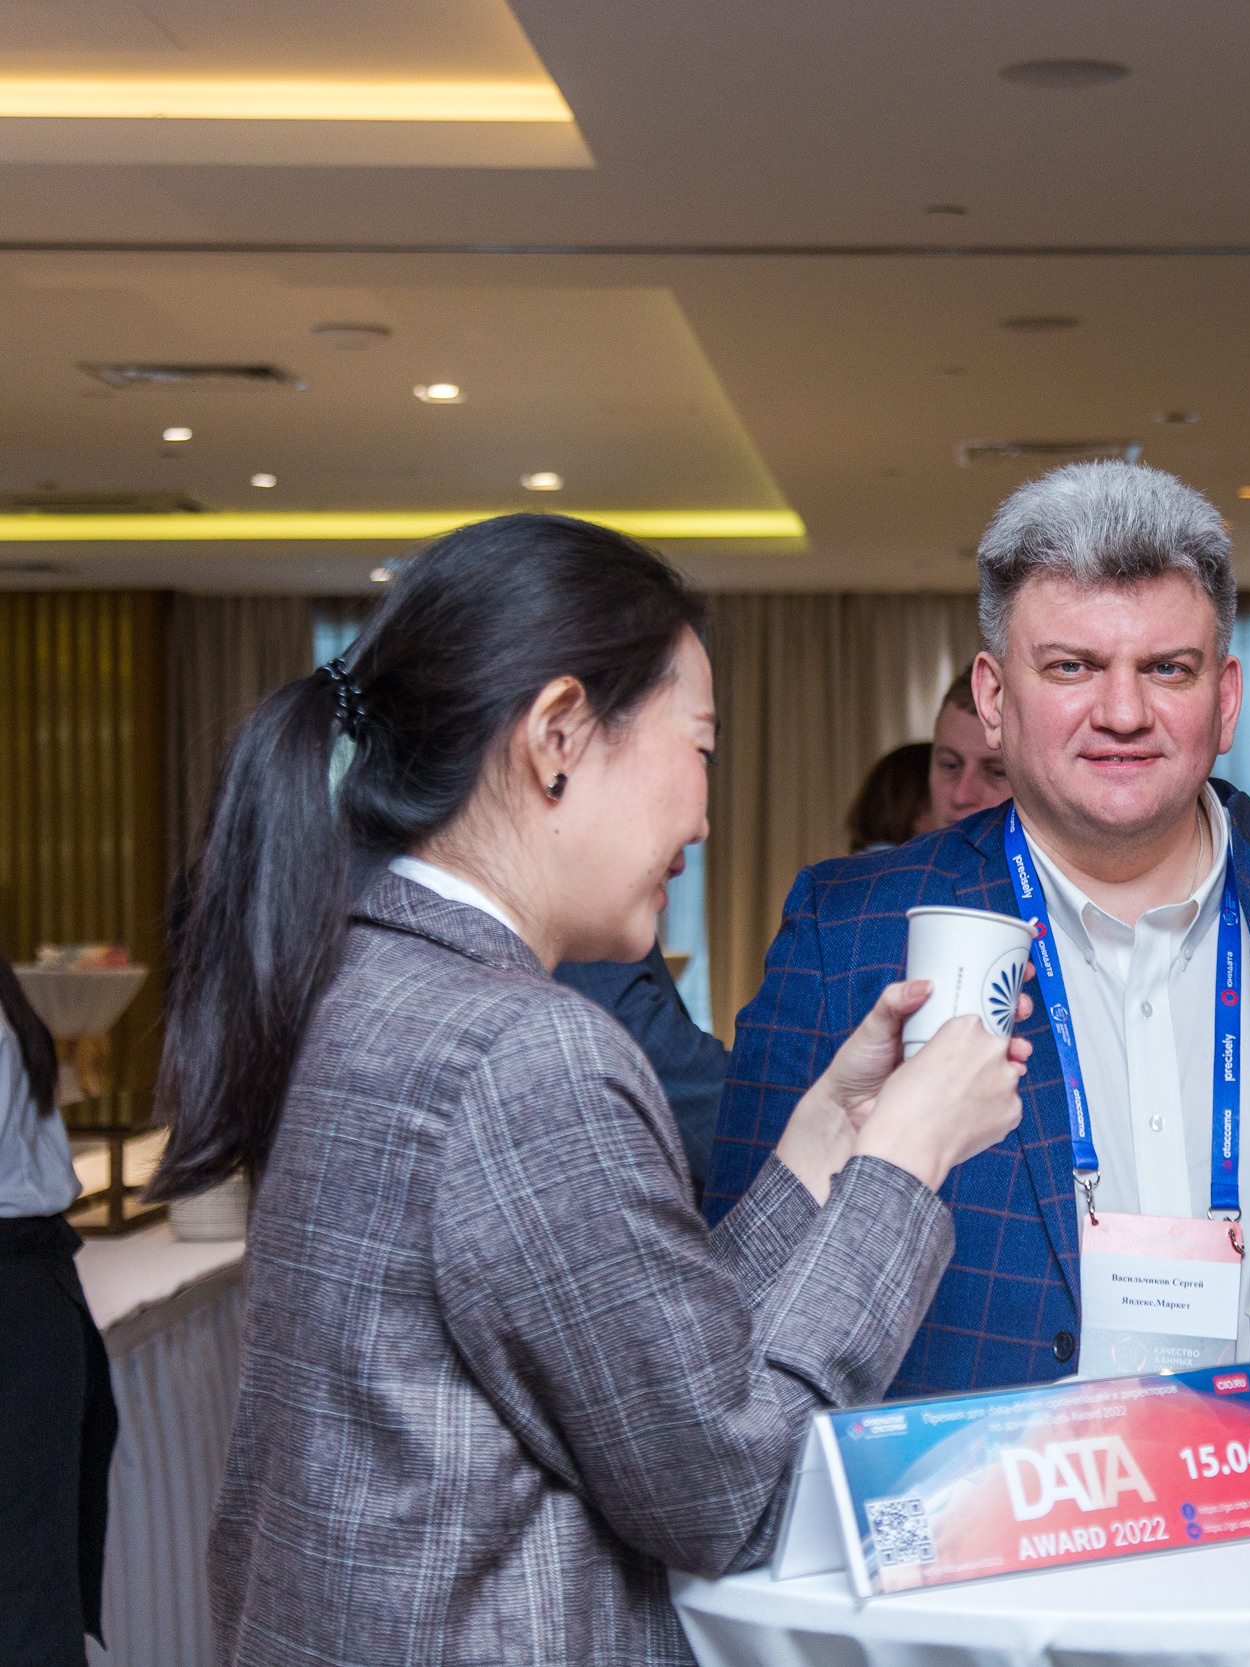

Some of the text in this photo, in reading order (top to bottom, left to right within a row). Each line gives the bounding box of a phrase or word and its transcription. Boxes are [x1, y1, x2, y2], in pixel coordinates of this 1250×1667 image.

[1012, 854, 1034, 899] precisely
[1222, 1033, 1236, 1082] precisely
[1073, 1089, 1085, 1138] ataccama
[1222, 1109, 1232, 1158] ataccama
[1111, 1273, 1204, 1289] Васильчиков Сергей
[1121, 1296, 1191, 1310] Яндекс.Маркет
[1153, 1345, 1200, 1359] КАЧЕСТВО
[1153, 1356, 1194, 1367] ДАННЫХ
[1217, 1378, 1246, 1391] CIO.RU
[1121, 1385, 1178, 1402] директоров
[1103, 1405, 1128, 1418] 2022
[1001, 1435, 1157, 1522] DATA
[1018, 1517, 1170, 1562] AWARD 2022
